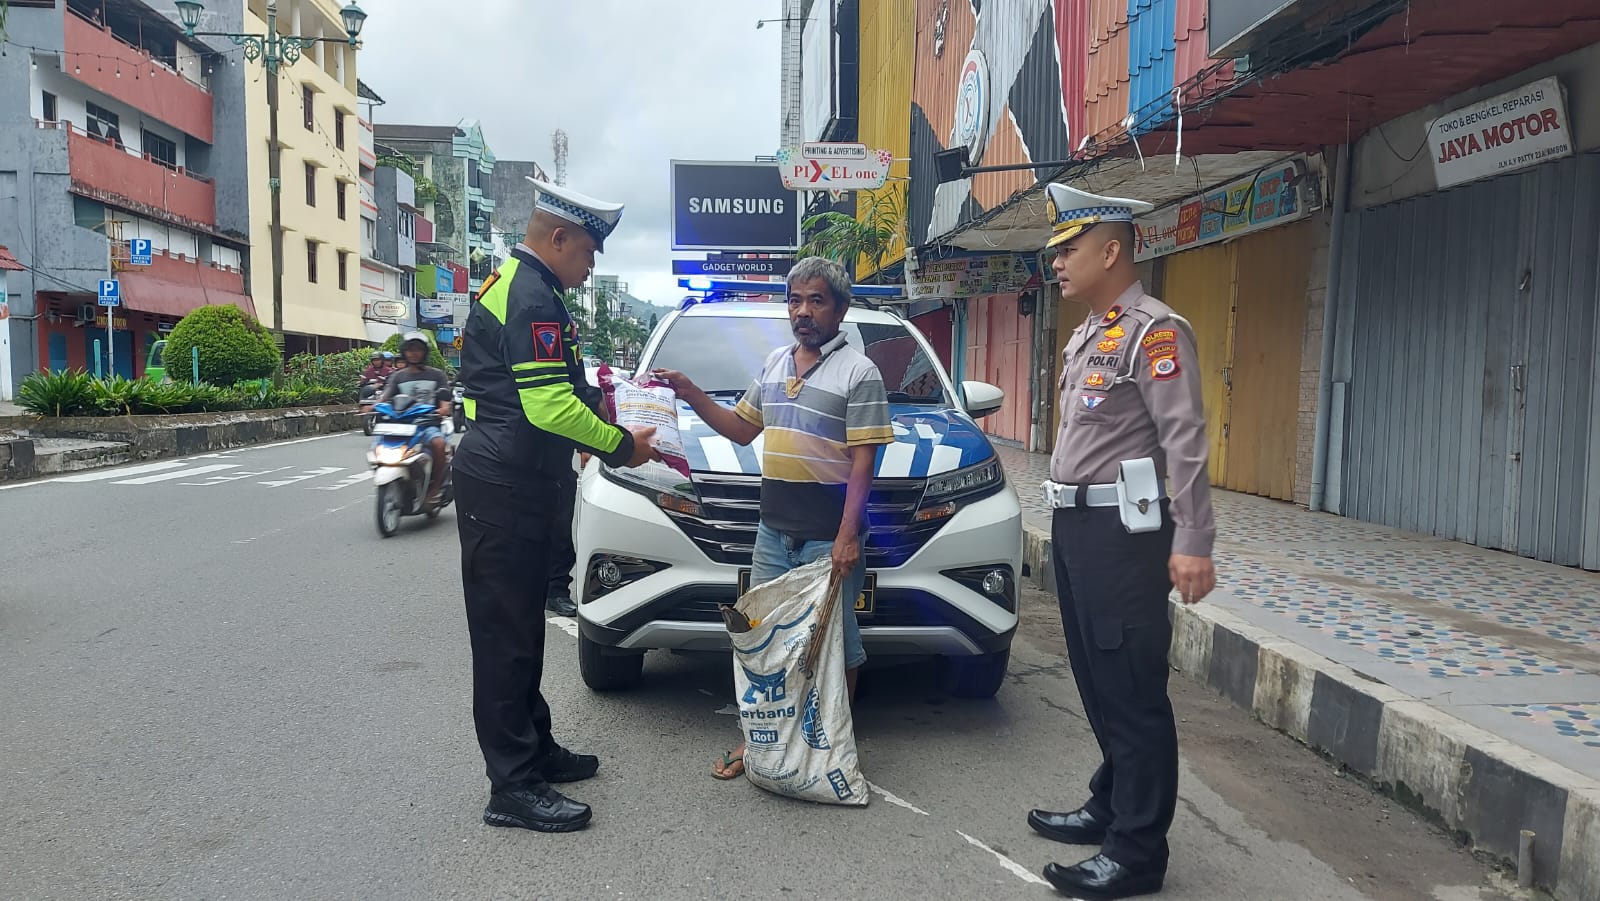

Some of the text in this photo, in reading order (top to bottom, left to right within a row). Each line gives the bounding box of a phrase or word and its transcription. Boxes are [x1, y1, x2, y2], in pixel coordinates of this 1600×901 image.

[1439, 90, 1545, 134] TOKO & BENGKEL REPARASI
[1438, 108, 1560, 164] JAYA MOTOR
[804, 146, 865, 156] PRINTING & ADVERTISING
[794, 160, 878, 183] PIXEL one
[689, 197, 784, 214] SAMSUNG
[702, 263, 773, 272] GADGET WORLD 3
[1087, 355, 1120, 367] POLRI
[740, 705, 796, 719] erbang
[751, 731, 776, 742] Roti
[831, 771, 850, 799] Roti
